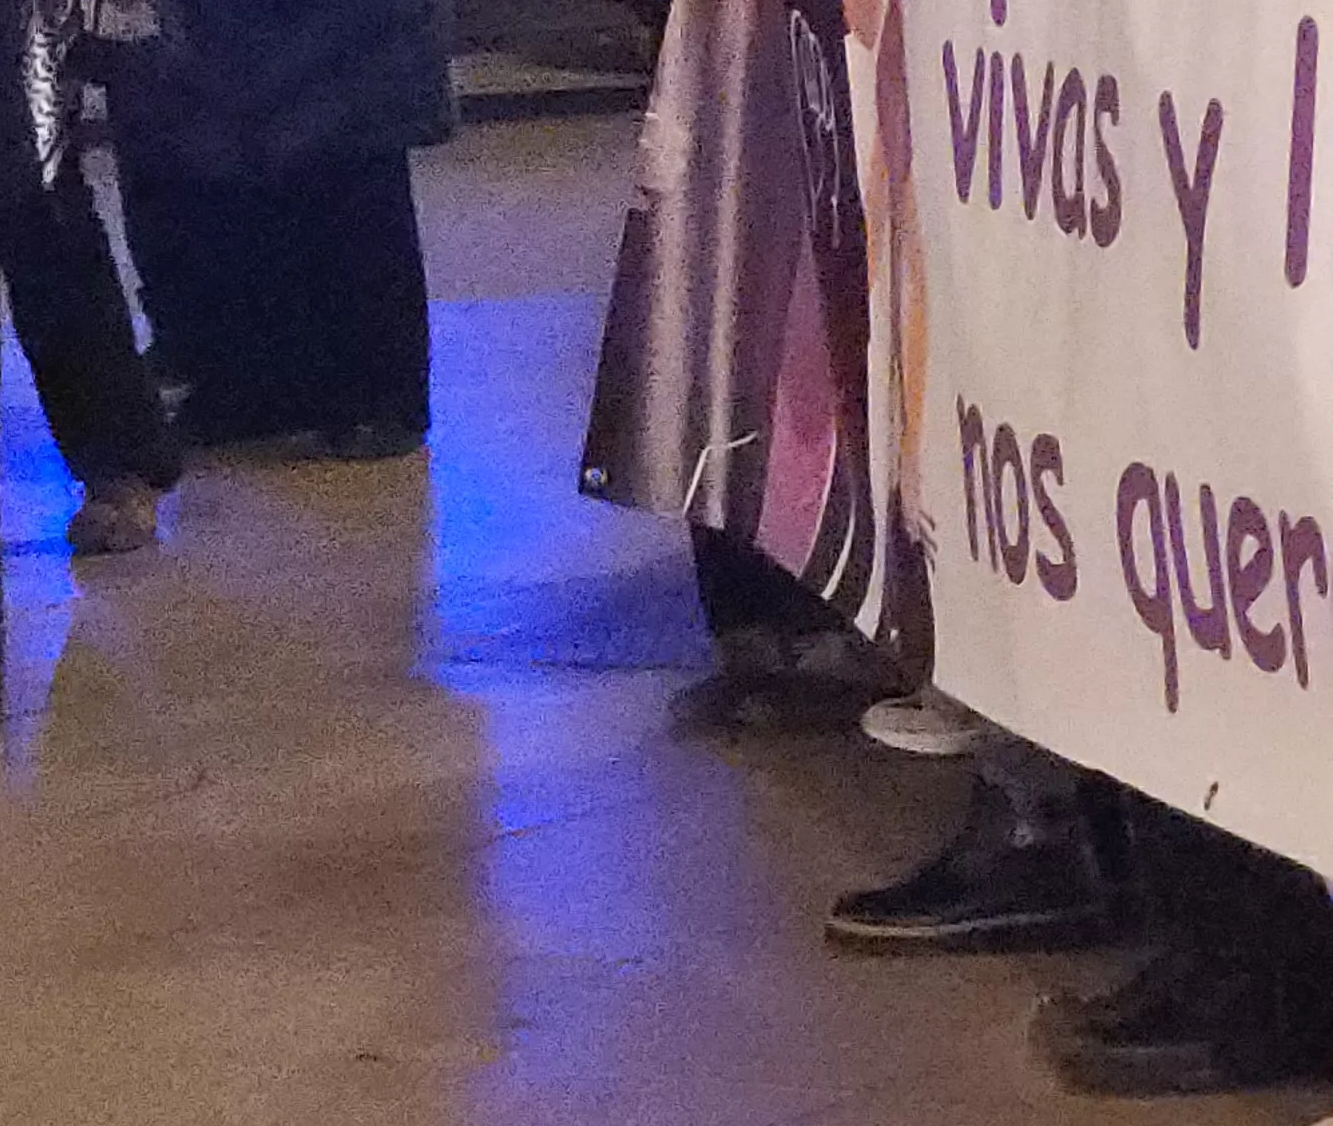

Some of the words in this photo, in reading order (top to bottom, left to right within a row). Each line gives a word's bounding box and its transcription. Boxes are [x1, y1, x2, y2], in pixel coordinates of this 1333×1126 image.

[1158, 90, 1224, 351] y
[956, 393, 1079, 602] nos
[1116, 460, 1330, 715] quer
